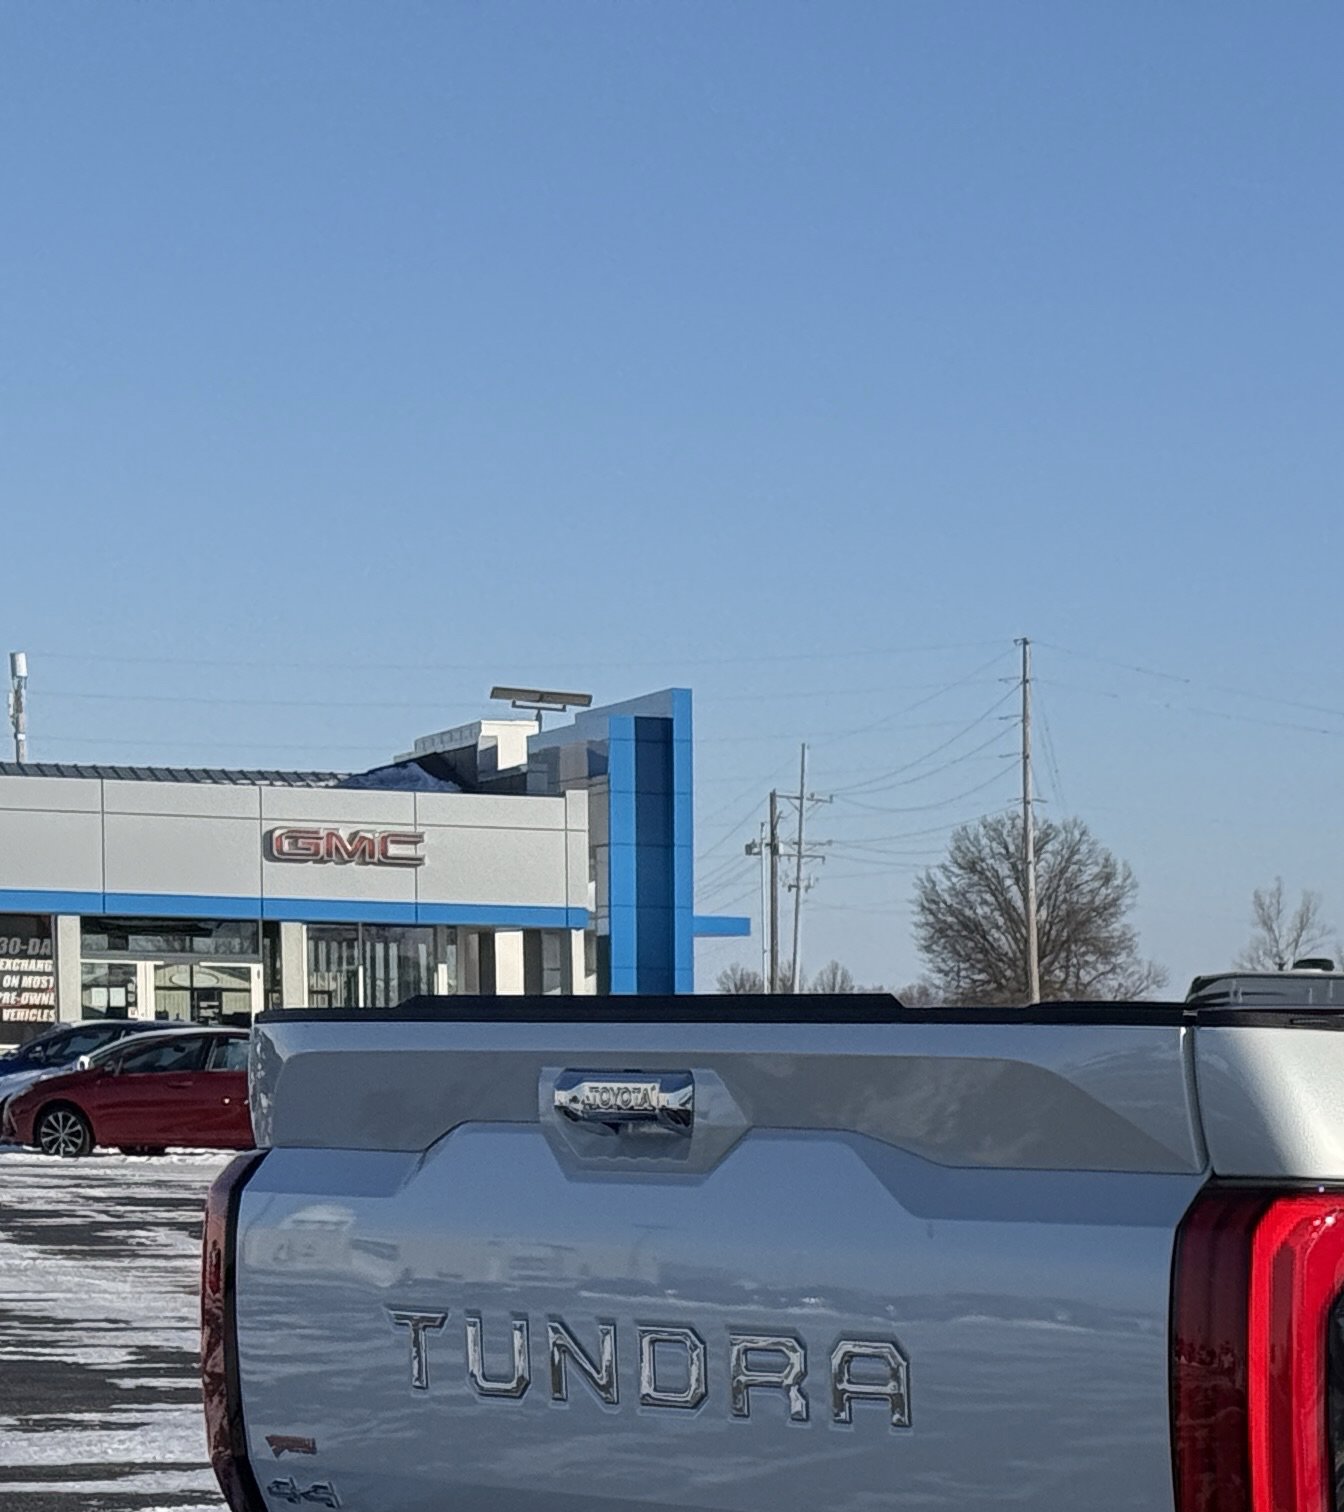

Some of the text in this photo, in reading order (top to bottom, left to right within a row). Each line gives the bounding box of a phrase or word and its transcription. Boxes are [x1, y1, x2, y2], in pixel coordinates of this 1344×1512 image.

[268, 827, 425, 865] GMC
[0, 937, 51, 955] 30-DA
[0, 958, 53, 972] EXCHANG
[3, 975, 55, 989] ON MOST
[2, 1008, 55, 1022] VEHICLES
[588, 1086, 656, 1109] TOYOTA
[387, 1306, 912, 1428] TUNDRA
